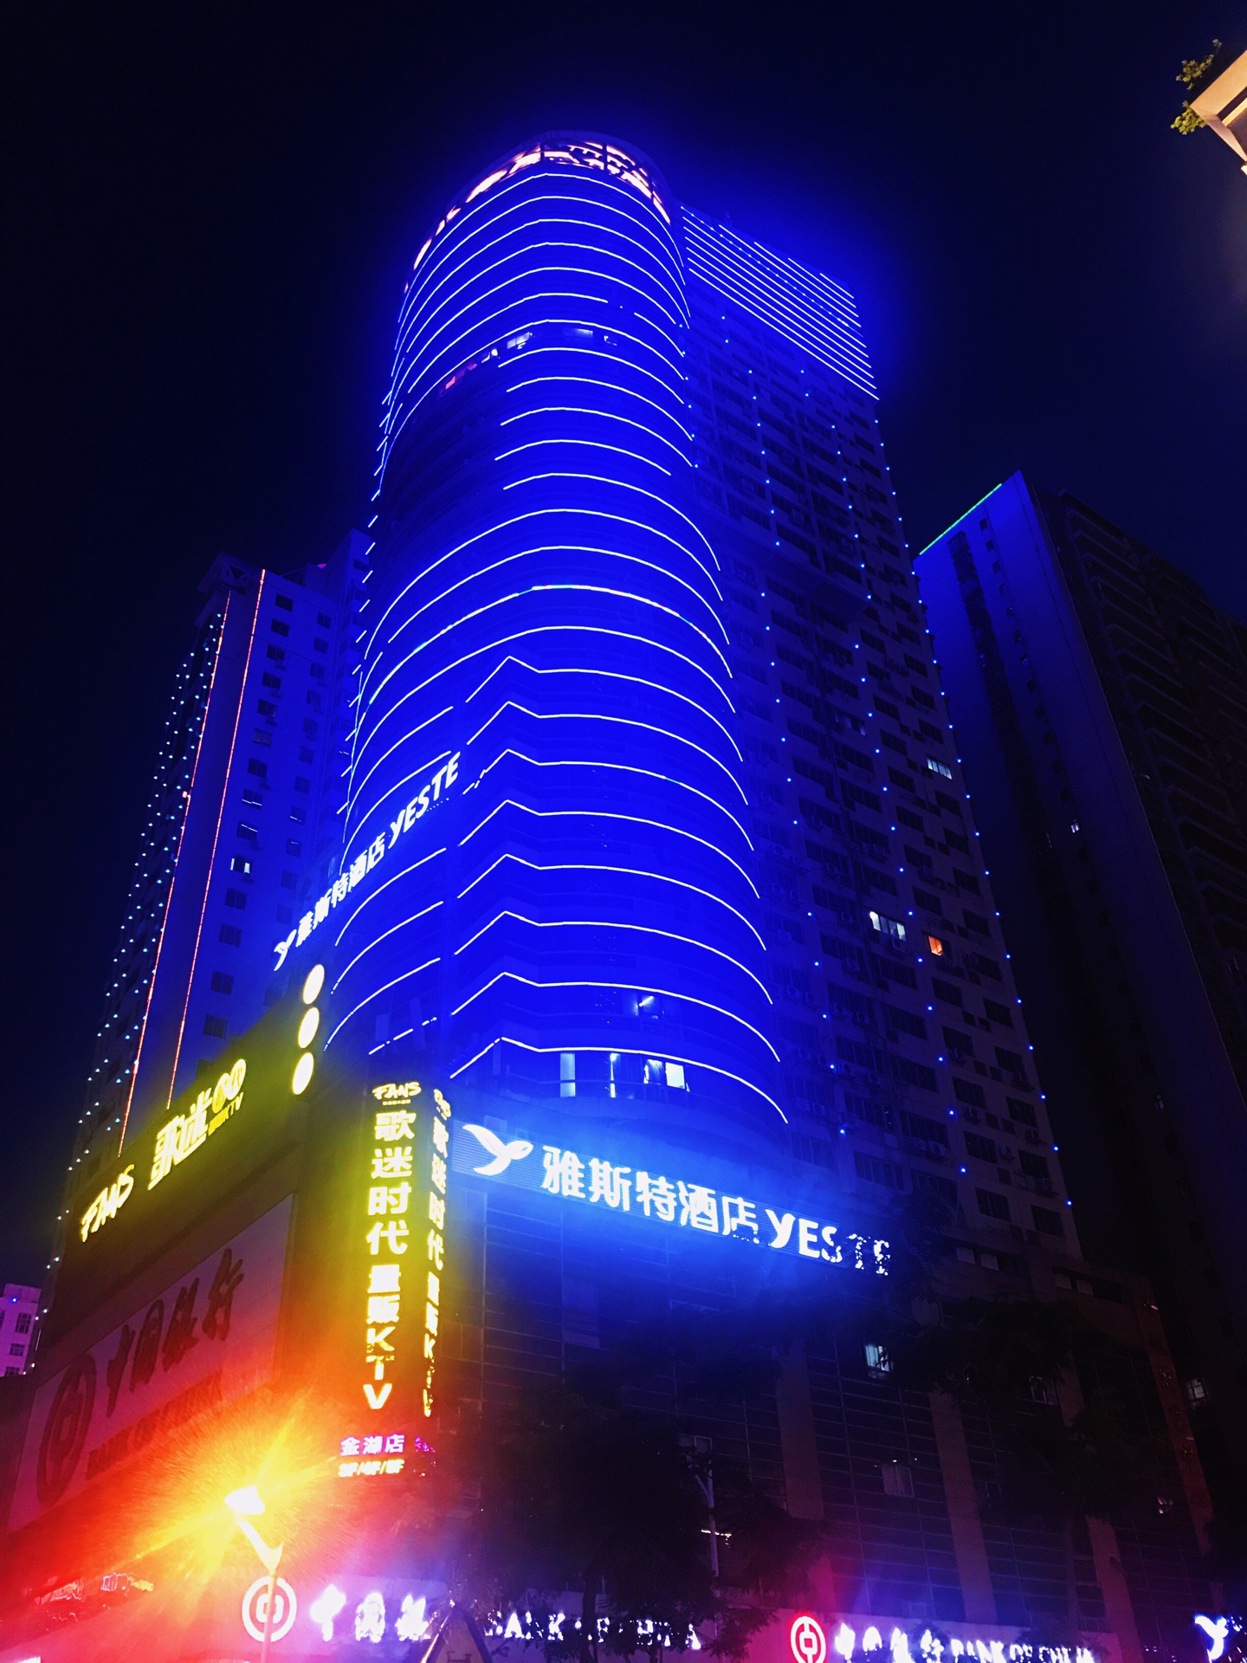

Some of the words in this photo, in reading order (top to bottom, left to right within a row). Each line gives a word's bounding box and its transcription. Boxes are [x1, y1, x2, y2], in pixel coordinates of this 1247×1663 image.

[388, 752, 461, 849] YESTE
[372, 1082, 421, 1100] FANS
[541, 1145, 759, 1244] 雅斯特酒店
